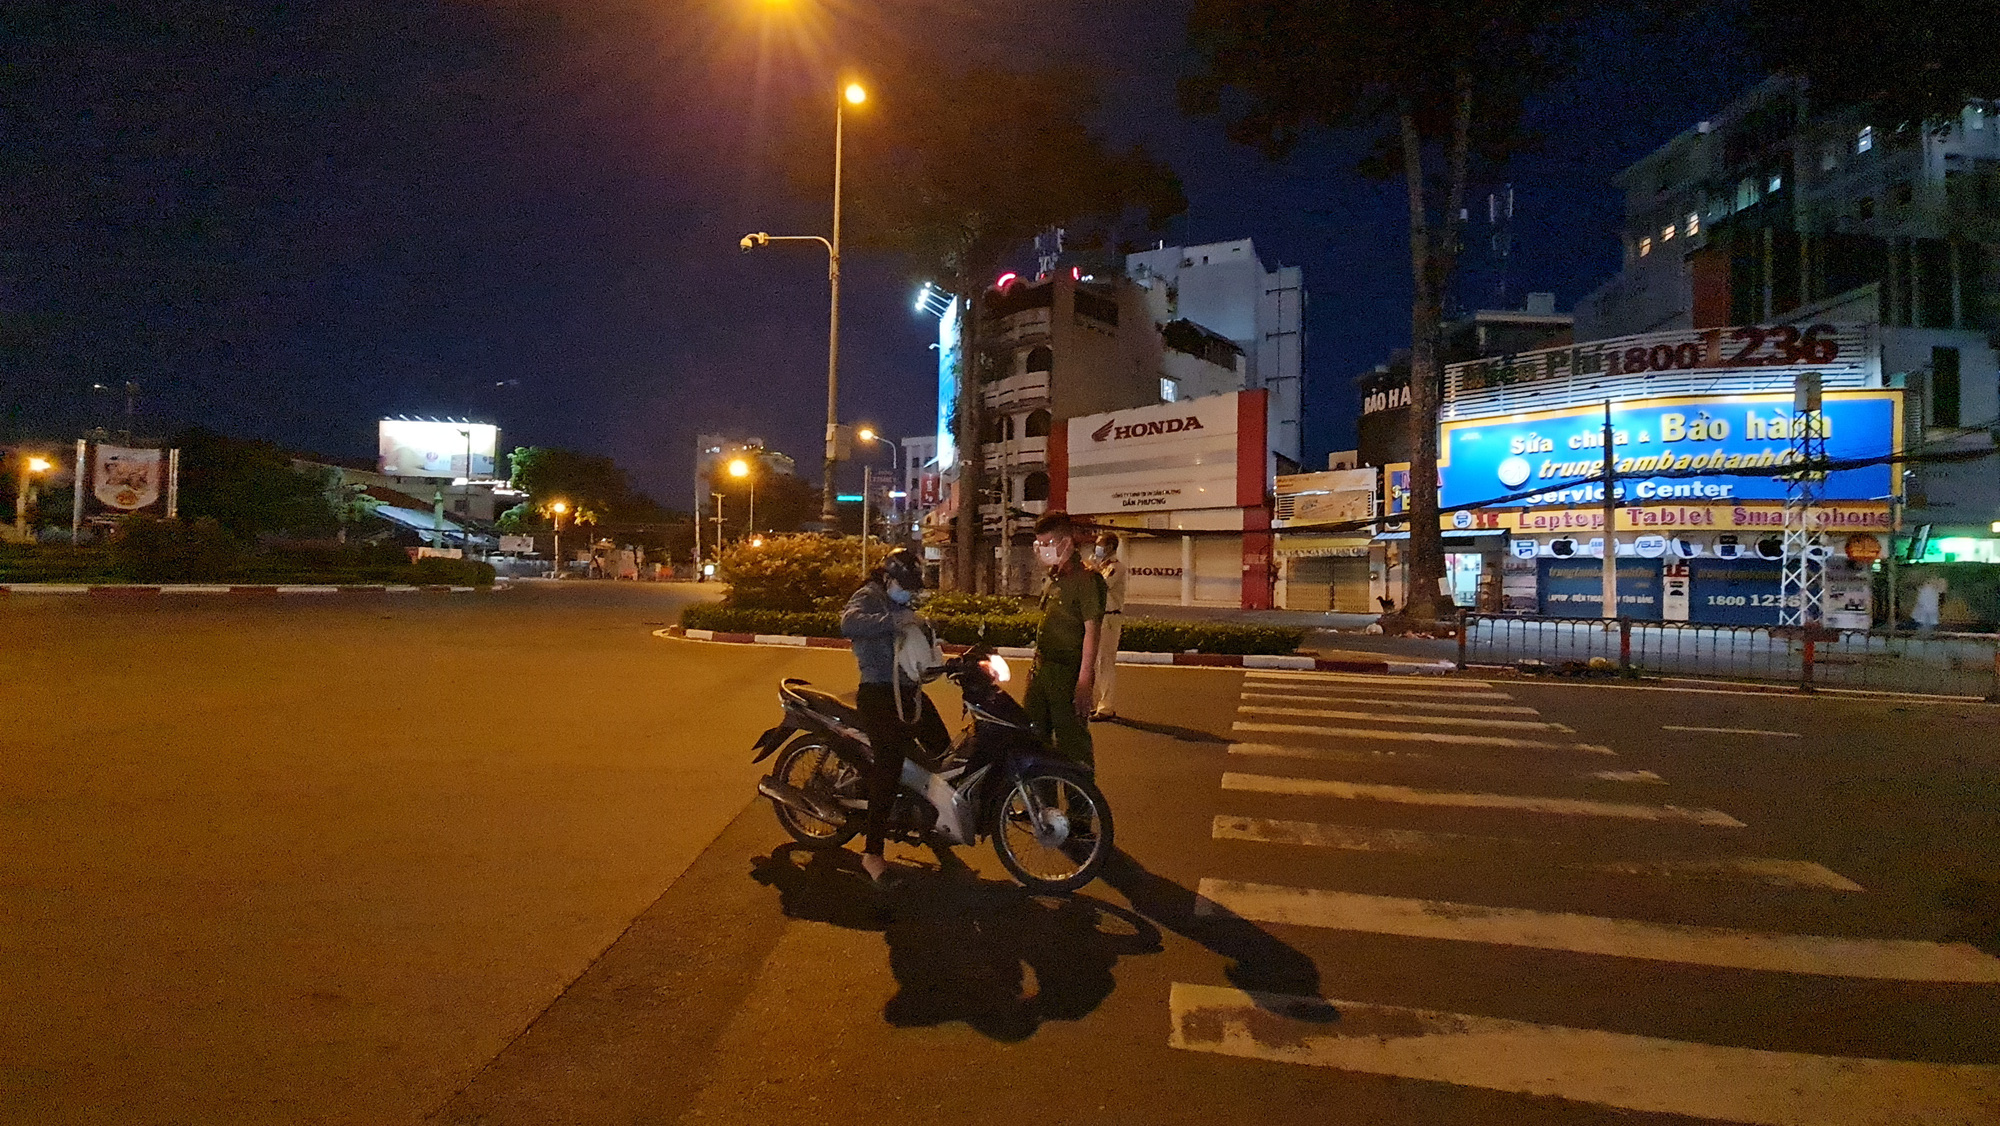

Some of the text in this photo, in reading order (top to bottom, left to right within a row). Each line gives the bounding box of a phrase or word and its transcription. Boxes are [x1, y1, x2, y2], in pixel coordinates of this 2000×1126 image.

[1606, 341, 1700, 377] 1800
[1700, 324, 1838, 369] 1236
[1364, 386, 1387, 415] BẢO
[1114, 416, 1204, 440] HONDA
[1511, 432, 1553, 455] Sửa
[1639, 431, 1650, 443] &
[1661, 411, 1729, 443] Bảo
[1746, 408, 1832, 440] hành
[1526, 480, 1733, 504] Service Center
[1519, 510, 1604, 531] Laptop
[1627, 506, 1713, 526] Tablet
[1637, 540, 1663, 549] ASUS
[1131, 567, 1182, 577] HONDA
[1708, 594, 1801, 607] 1800 1236
